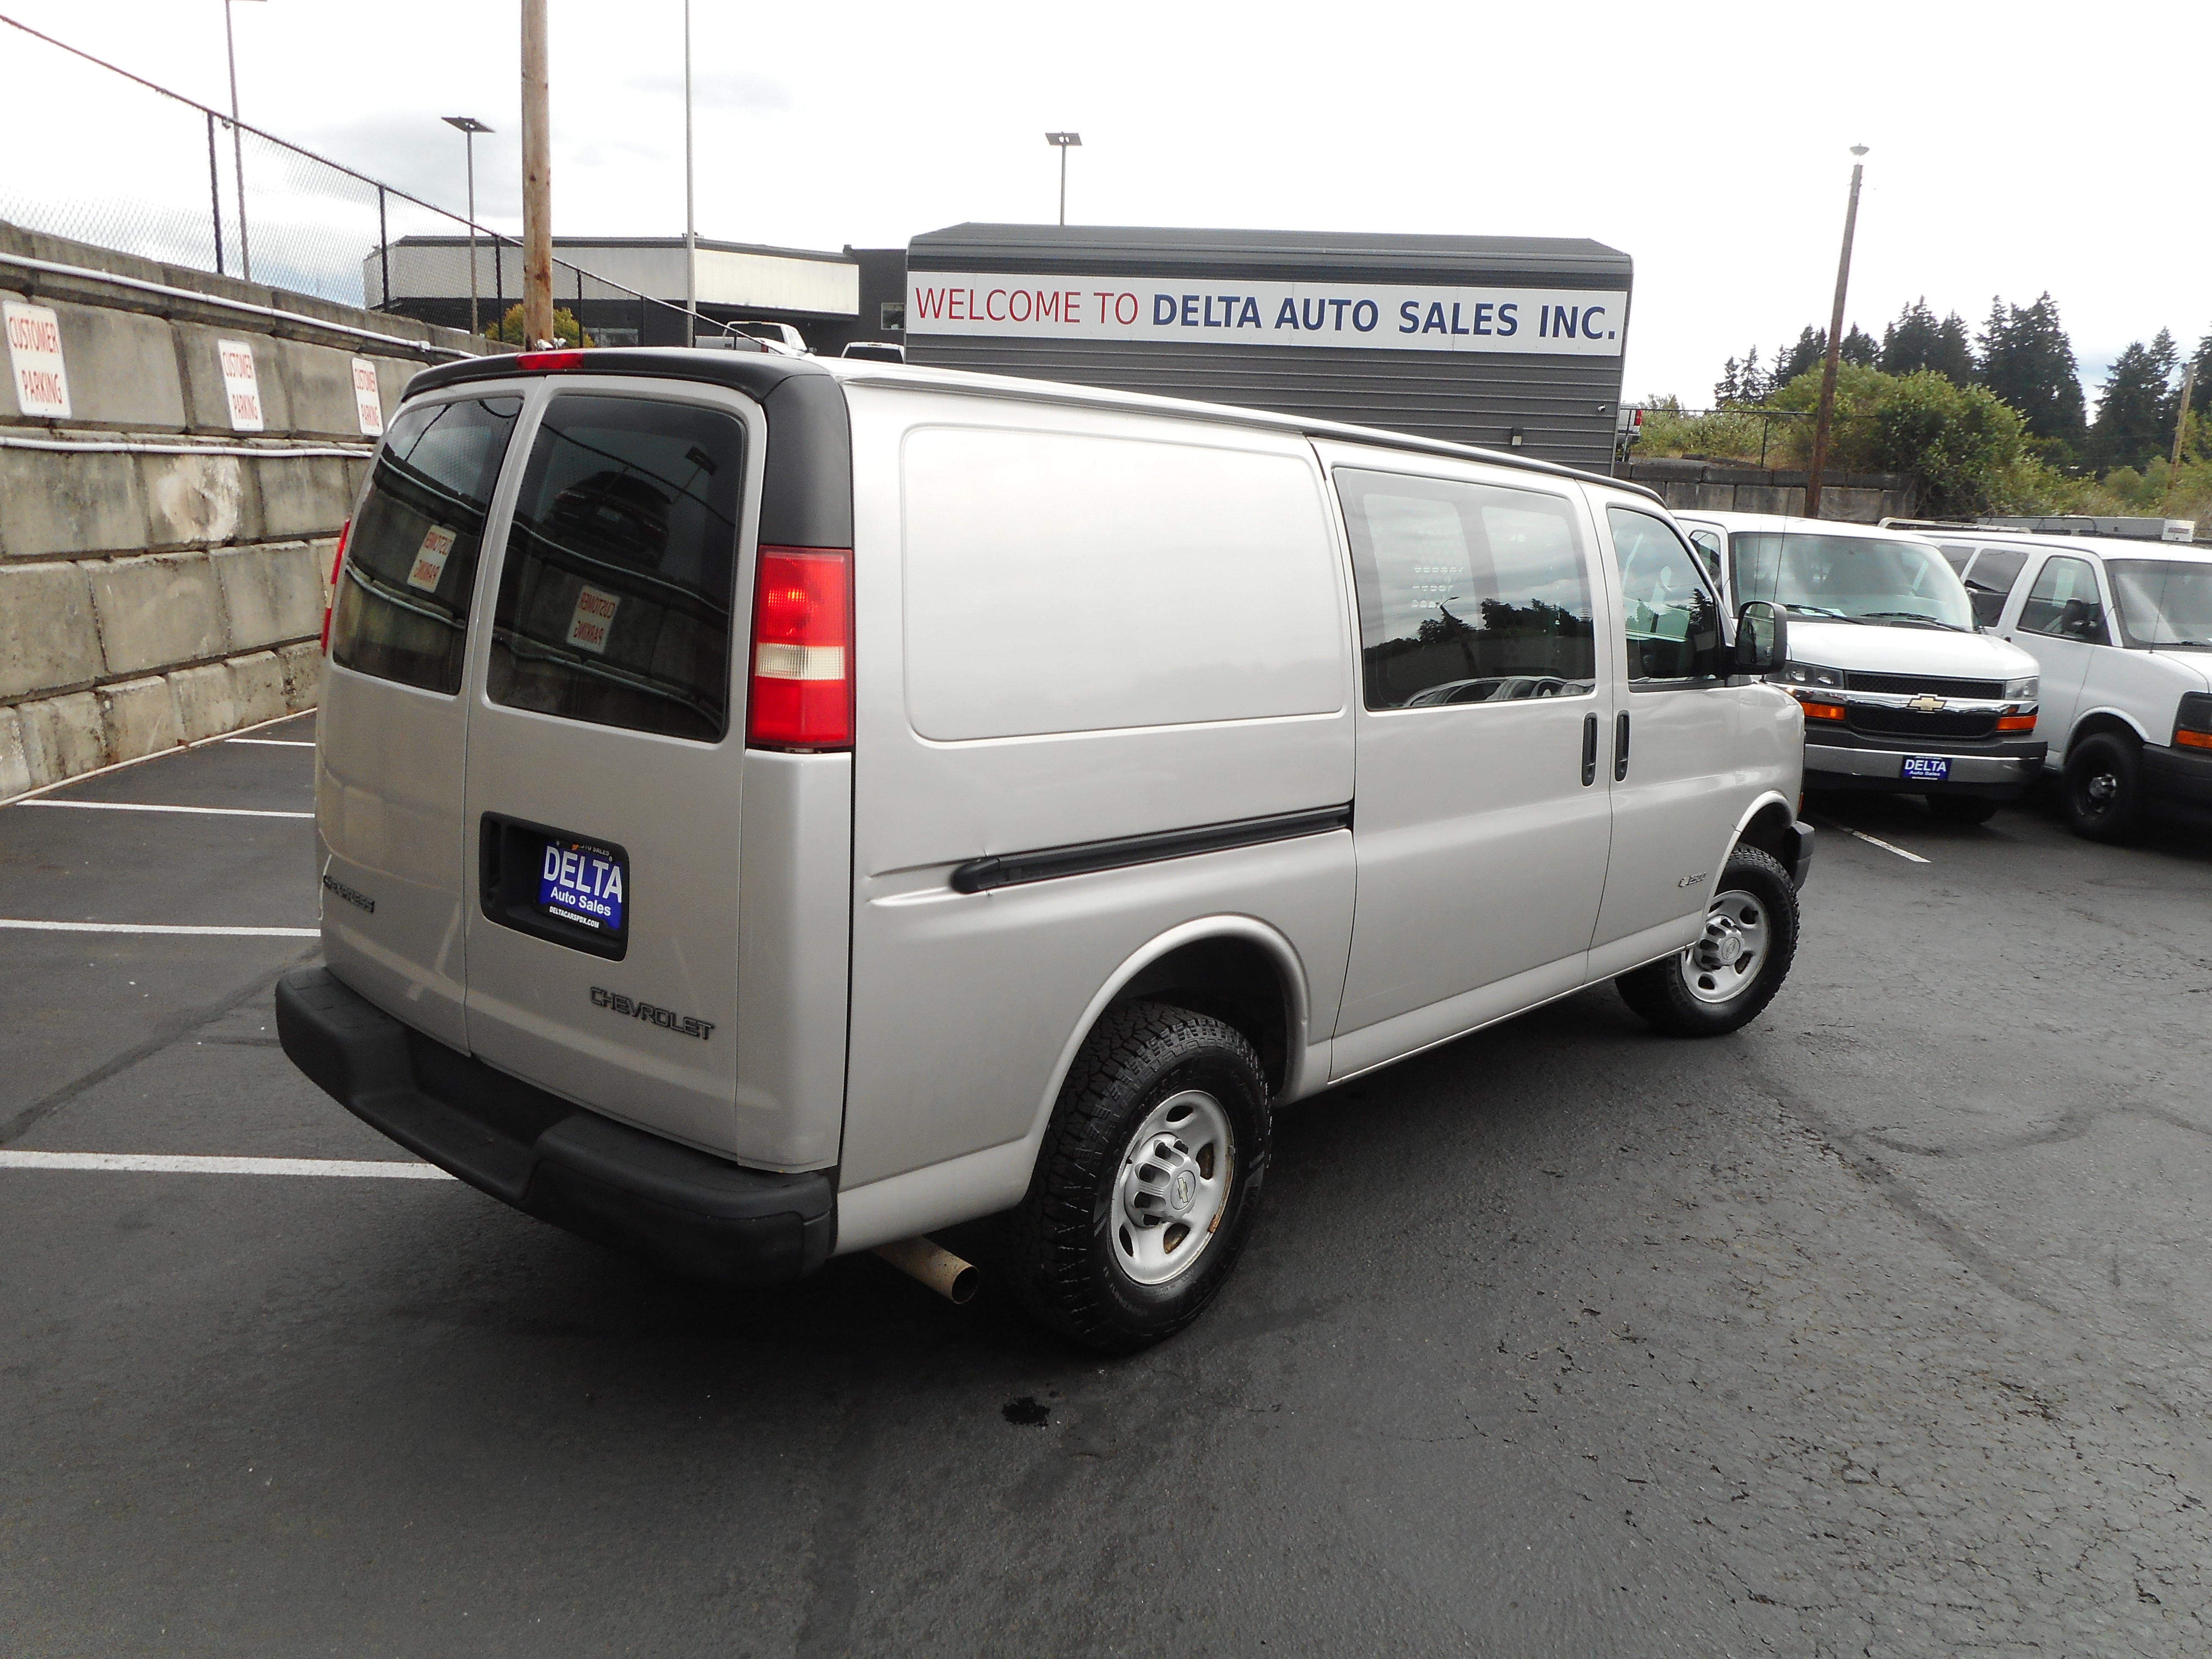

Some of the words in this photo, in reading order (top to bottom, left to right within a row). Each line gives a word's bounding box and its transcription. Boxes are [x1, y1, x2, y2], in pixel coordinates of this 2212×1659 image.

[915, 288, 1081, 324] WELCOME
[1093, 292, 1139, 325] TO
[1152, 294, 1263, 329] DELTA
[1274, 297, 1379, 332] AUTO
[1398, 301, 1519, 337] SALES
[1539, 304, 1617, 340] INC.
[9, 316, 59, 354] CUSTOMER
[222, 351, 255, 380] CUSTOMER
[355, 368, 377, 393] CUSTOMER
[21, 370, 63, 404] PARKING
[232, 394, 258, 420] PARKING
[361, 404, 380, 427] PARKING
[1905, 759, 1947, 772] DELTA
[544, 845, 622, 903] DELTA
[550, 886, 576, 905] Auto
[578, 895, 611, 917] Sales
[549, 905, 599, 929] DELTACARSPDX.COM
[589, 986, 716, 1040] CHEVROLET
